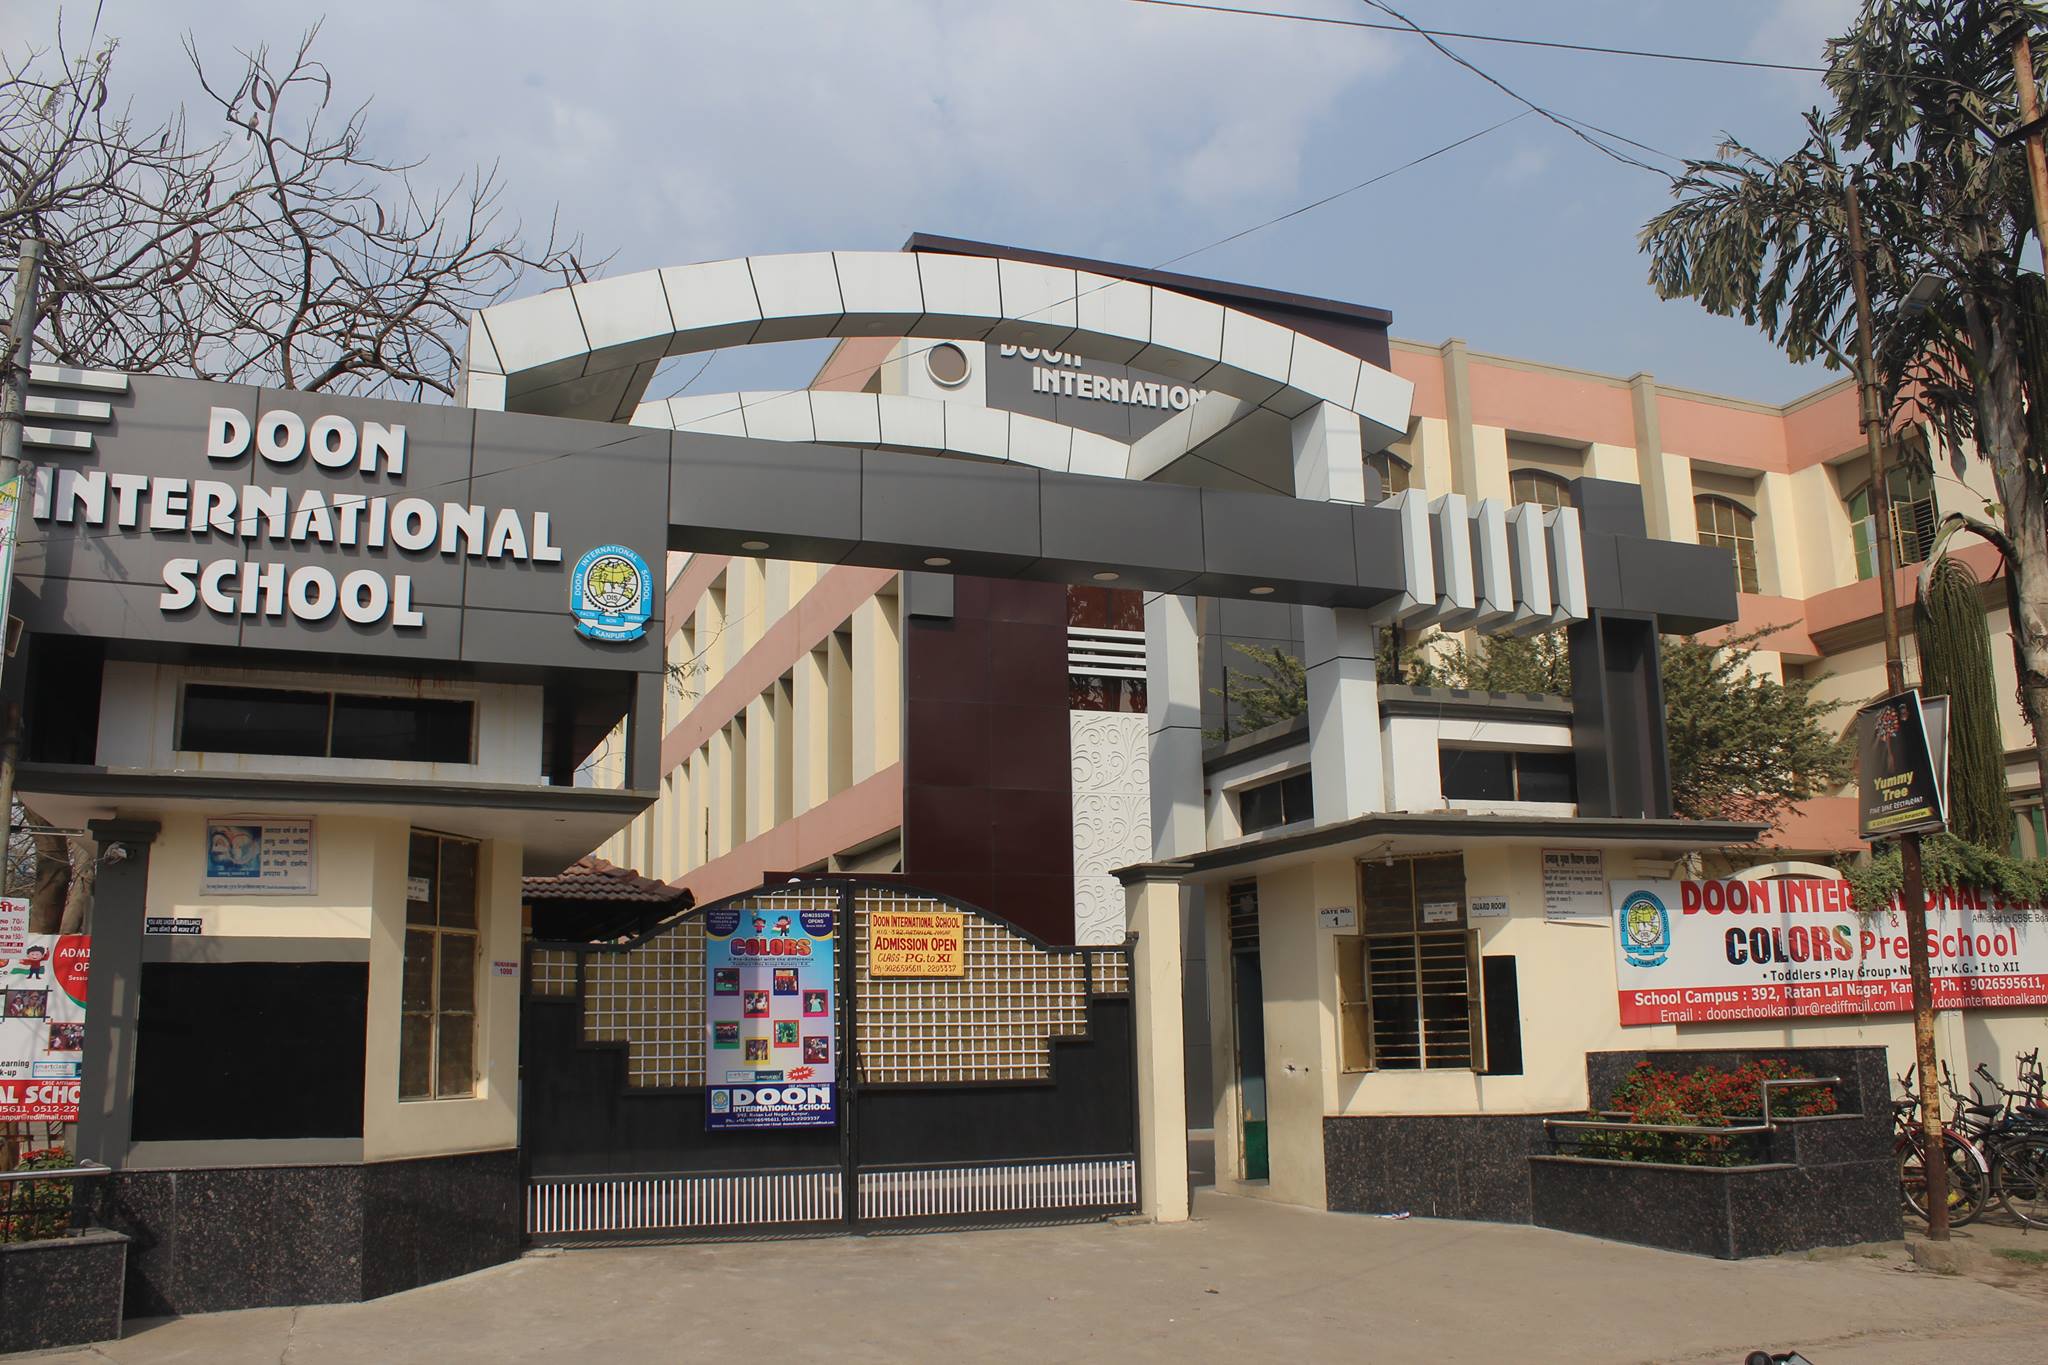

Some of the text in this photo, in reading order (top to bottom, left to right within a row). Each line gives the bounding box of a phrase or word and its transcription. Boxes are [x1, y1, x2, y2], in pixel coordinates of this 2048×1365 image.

[208, 406, 406, 474] DOON
[33, 466, 563, 561] INTERNATIONAL
[581, 546, 637, 566] INTERNATIONAL
[574, 573, 582, 596] DOON
[641, 569, 650, 601] SCHOOL
[160, 558, 425, 627] SCHOOL
[595, 630, 625, 639] KANPUR
[1873, 771, 1914, 791] Yummy
[1882, 787, 1909, 801] Tree
[1680, 880, 1771, 915] DOON
[1320, 907, 1353, 916] GATE NO.
[1471, 901, 1507, 912] GUARD ROOM
[873, 914, 960, 929] DOON INTERNATIONAL SCHOOL
[1332, 916, 1340, 927] 1
[1890, 914, 1900, 928] &
[2012, 912, 2034, 923] CBSE
[730, 938, 812, 957] COLORS
[874, 936, 957, 952] ADMISSION OPEN
[1724, 925, 1854, 966] COLORS
[1926, 927, 2018, 958] School
[60, 948, 91, 958] ADMI
[936, 953, 952, 963] XI
[1769, 968, 1821, 982] Toddlers
[1830, 966, 1854, 981] Play
[1858, 965, 1891, 979] Group
[1951, 962, 1973, 974] K.G.
[1981, 961, 1986, 972] I
[1989, 963, 1999, 973] to
[2002, 961, 2020, 973] XII
[1634, 990, 1681, 1007] School
[1686, 988, 1739, 1006] Campus
[1751, 987, 1780, 1002] 392,
[1784, 985, 1821, 999] Ratan
[1825, 983, 1843, 997] Lal
[1846, 981, 1888, 998] Nagar,
[1940, 978, 1960, 992] Ph.
[1970, 976, 2046, 991] 9026595611,
[1660, 1008, 1694, 1023] Email
[0, 1060, 30, 1069] earning
[732, 1087, 831, 1106] DOON
[32, 1105, 80, 1113] 0512-22
[732, 1103, 831, 1112] INTERNATIONAL SCHOOL
